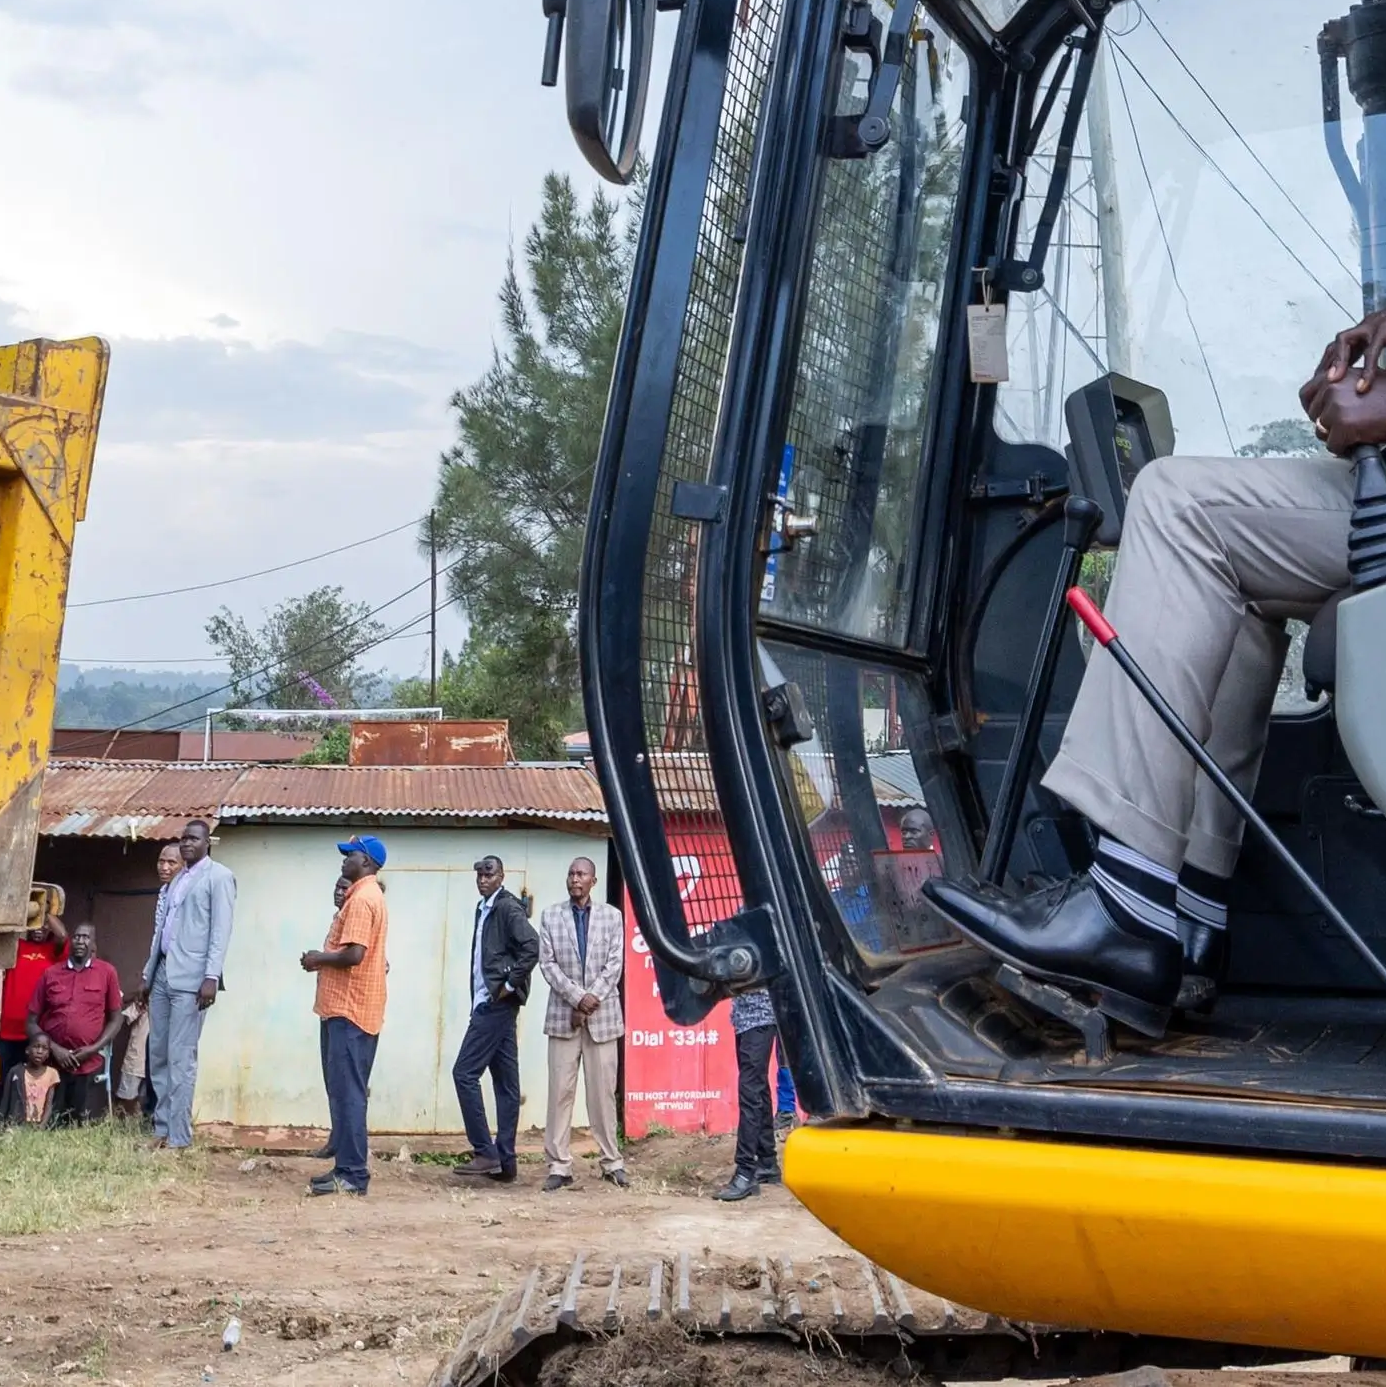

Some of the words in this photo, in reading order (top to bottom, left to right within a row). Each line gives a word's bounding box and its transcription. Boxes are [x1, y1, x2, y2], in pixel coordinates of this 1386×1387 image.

[632, 1030, 664, 1046] Dial
[628, 1092, 644, 1102] THE
[645, 1092, 668, 1101] MOST
[670, 1090, 721, 1100] AFFORDABLE
[654, 1101, 694, 1110] NETWORK
